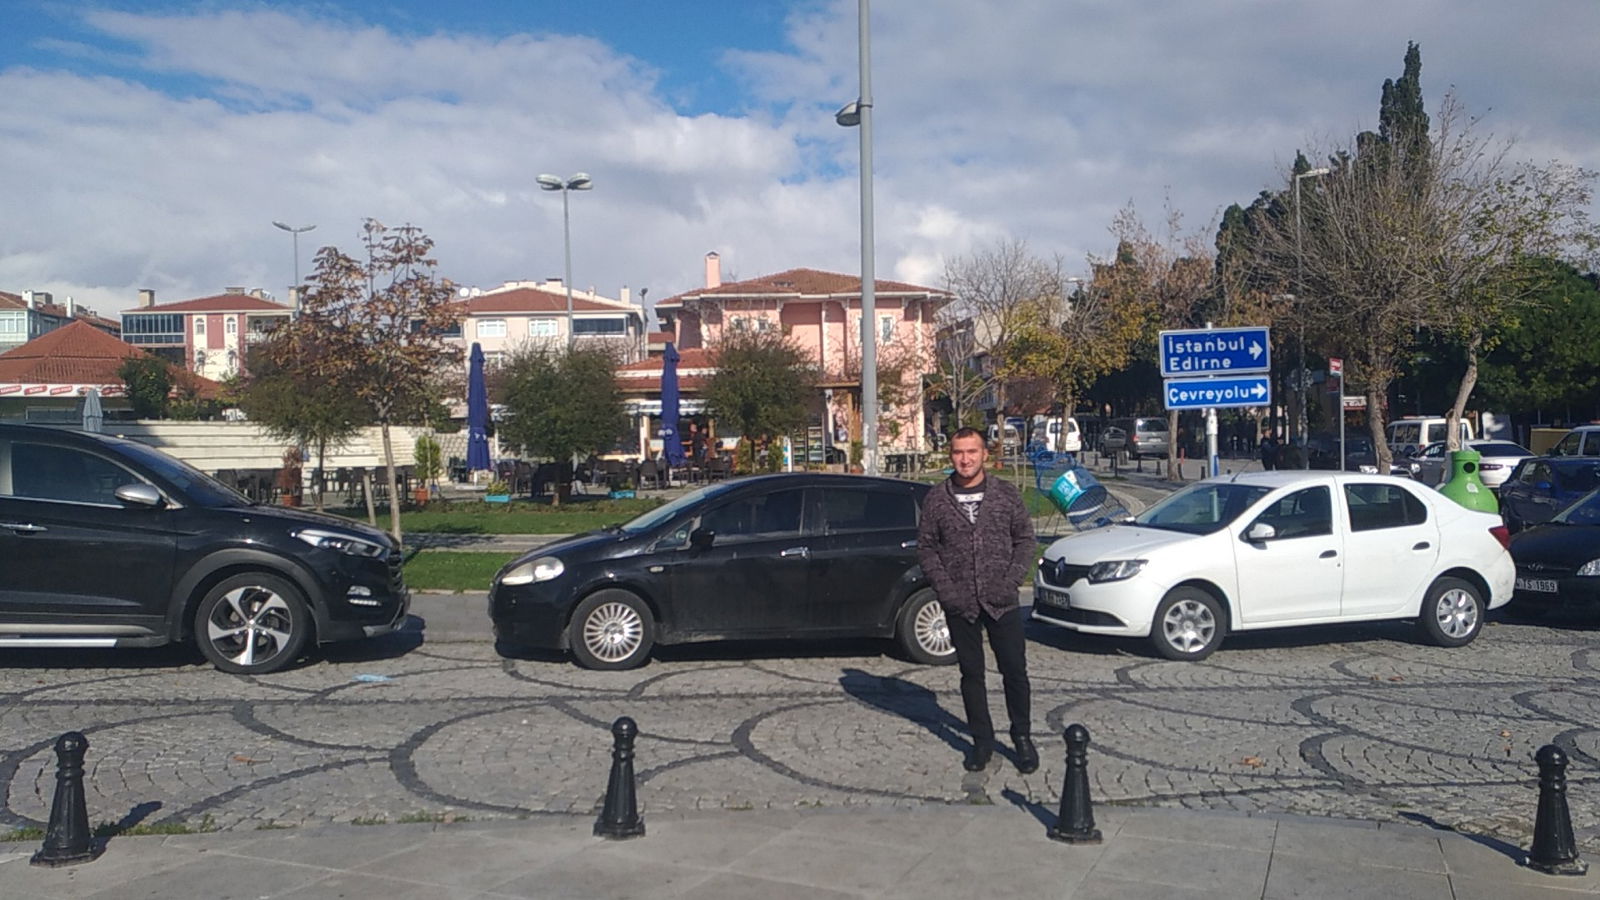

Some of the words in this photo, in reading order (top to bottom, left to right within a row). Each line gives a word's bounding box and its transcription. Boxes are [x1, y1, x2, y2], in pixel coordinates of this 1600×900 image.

[1168, 336, 1245, 353] İstanbul
[1169, 356, 1232, 371] Edirne
[1169, 385, 1249, 403] Çevreyolu
